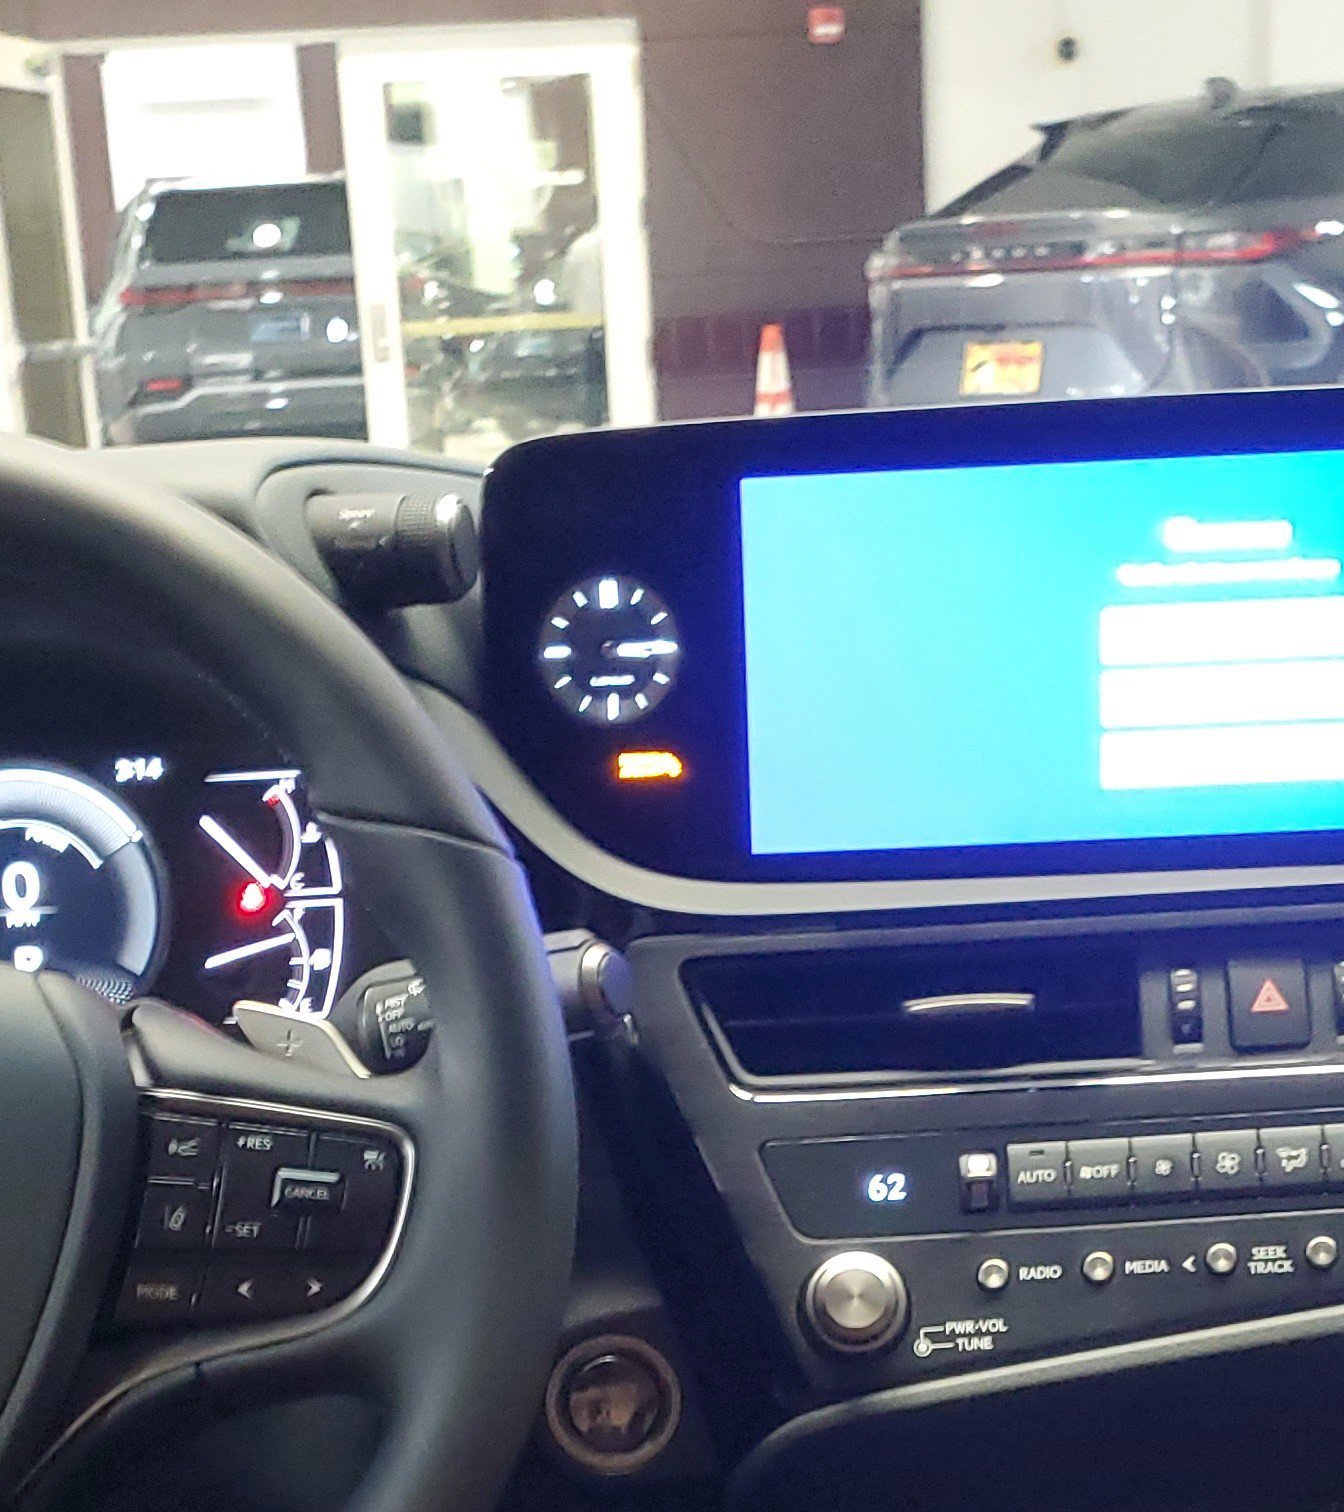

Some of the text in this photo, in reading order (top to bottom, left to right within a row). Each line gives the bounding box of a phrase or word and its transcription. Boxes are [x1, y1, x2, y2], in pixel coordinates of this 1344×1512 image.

[1, 861, 40, 911] 0
[1017, 1168, 1057, 1184] AUTO
[284, 1184, 331, 1200] CANCEL
[865, 1172, 908, 1203] 62
[1251, 1245, 1288, 1260] SEEK
[1019, 1264, 1063, 1281] RADIO
[1124, 1260, 1170, 1275] MEDIA
[1246, 1259, 1294, 1275] TRACK
[136, 1282, 178, 1301] MODE
[956, 1335, 995, 1352] TUNE
